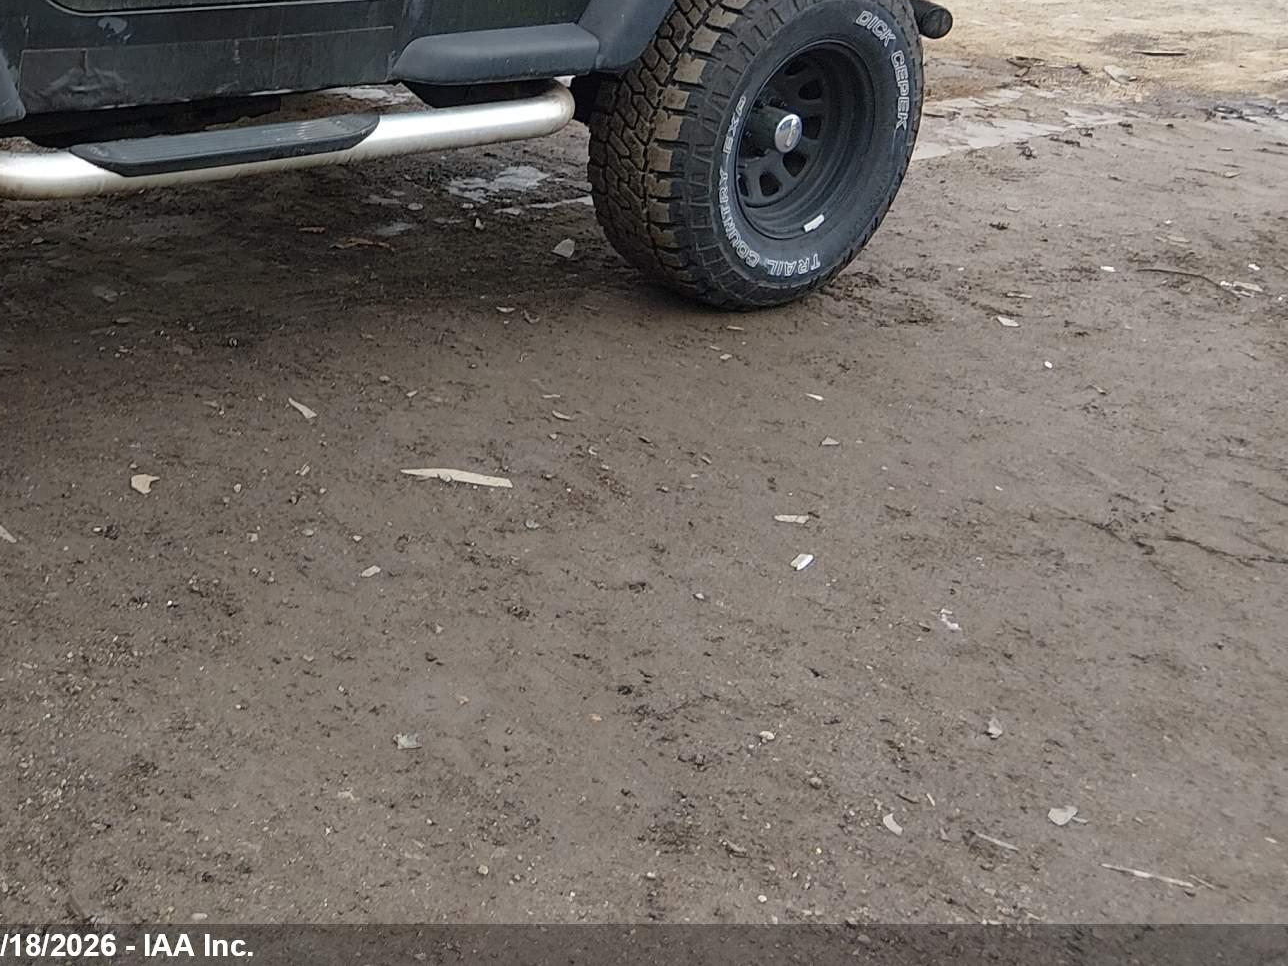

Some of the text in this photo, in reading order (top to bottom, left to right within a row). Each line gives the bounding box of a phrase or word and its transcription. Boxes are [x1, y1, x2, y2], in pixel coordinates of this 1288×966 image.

[855, 10, 911, 131] DICK CEPEK
[719, 96, 822, 277] TRAIL COUNTRY EXP
